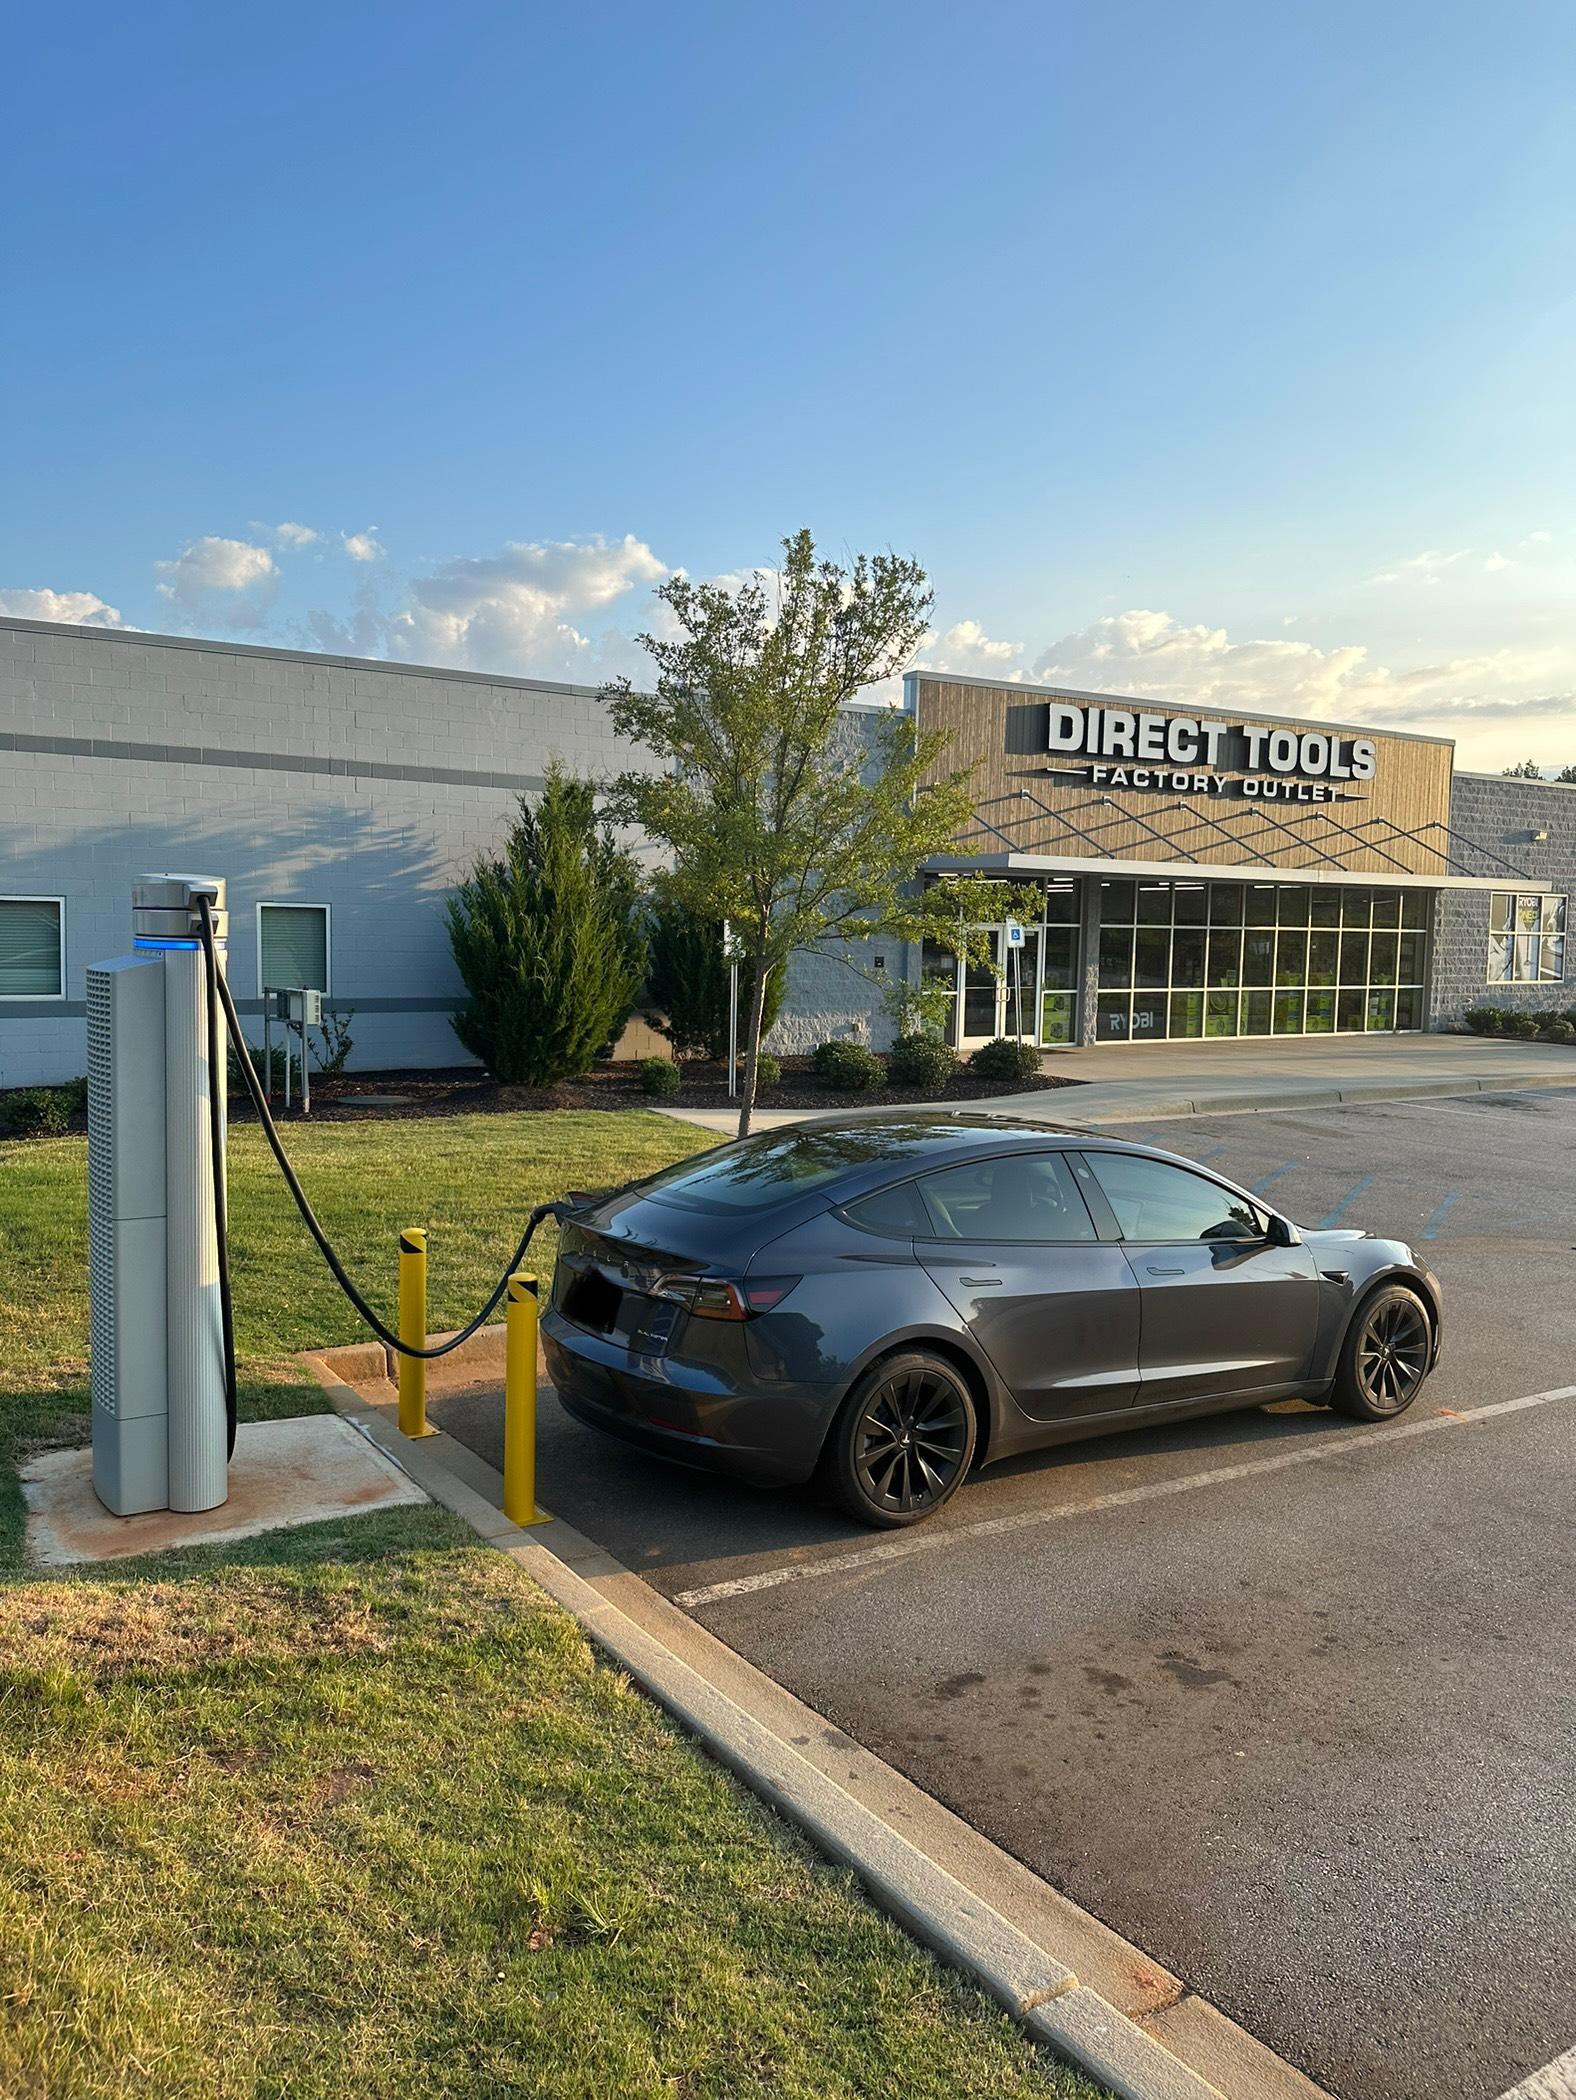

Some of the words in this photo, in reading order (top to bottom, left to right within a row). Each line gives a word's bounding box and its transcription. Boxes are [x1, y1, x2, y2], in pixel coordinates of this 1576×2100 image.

[1048, 702, 1227, 765] DIRECT
[1243, 725, 1376, 780] TOOLS
[1093, 765, 1227, 793] FACTORY
[1243, 778, 1340, 803] OUTLET
[1110, 1011, 1154, 1031] RYOBI
